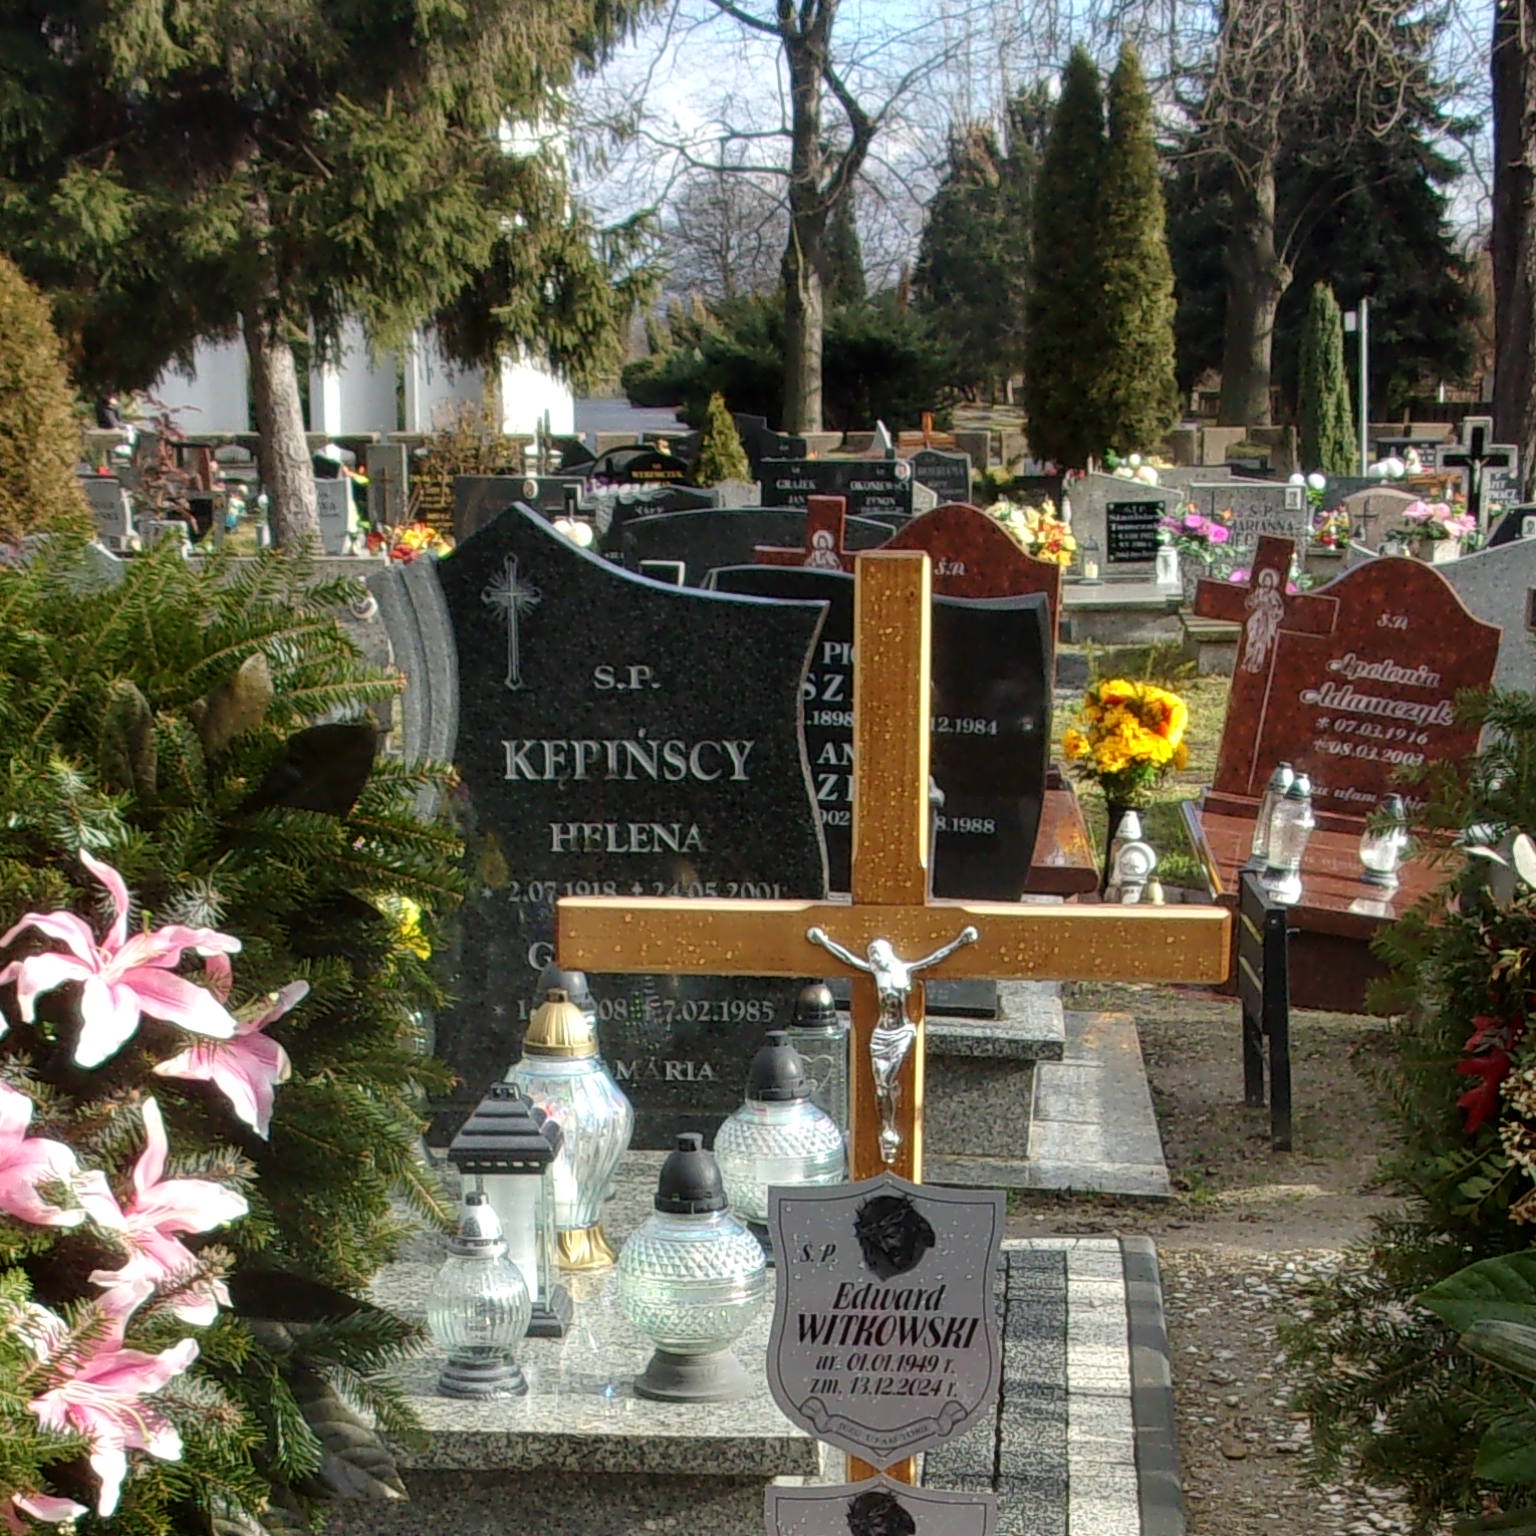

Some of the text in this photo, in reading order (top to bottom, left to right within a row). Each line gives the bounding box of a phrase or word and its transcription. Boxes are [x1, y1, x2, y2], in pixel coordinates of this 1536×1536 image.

[1300, 682, 1454, 727] Adamczyk
[549, 822, 705, 853] HELENA
[832, 1282, 946, 1311] Edward
[798, 1313, 980, 1349] WITKOWSKI
[847, 1354, 939, 1373] 01.01.1949
[809, 1378, 842, 1396] zm.
[850, 1377, 942, 1397] 13.12.2024
